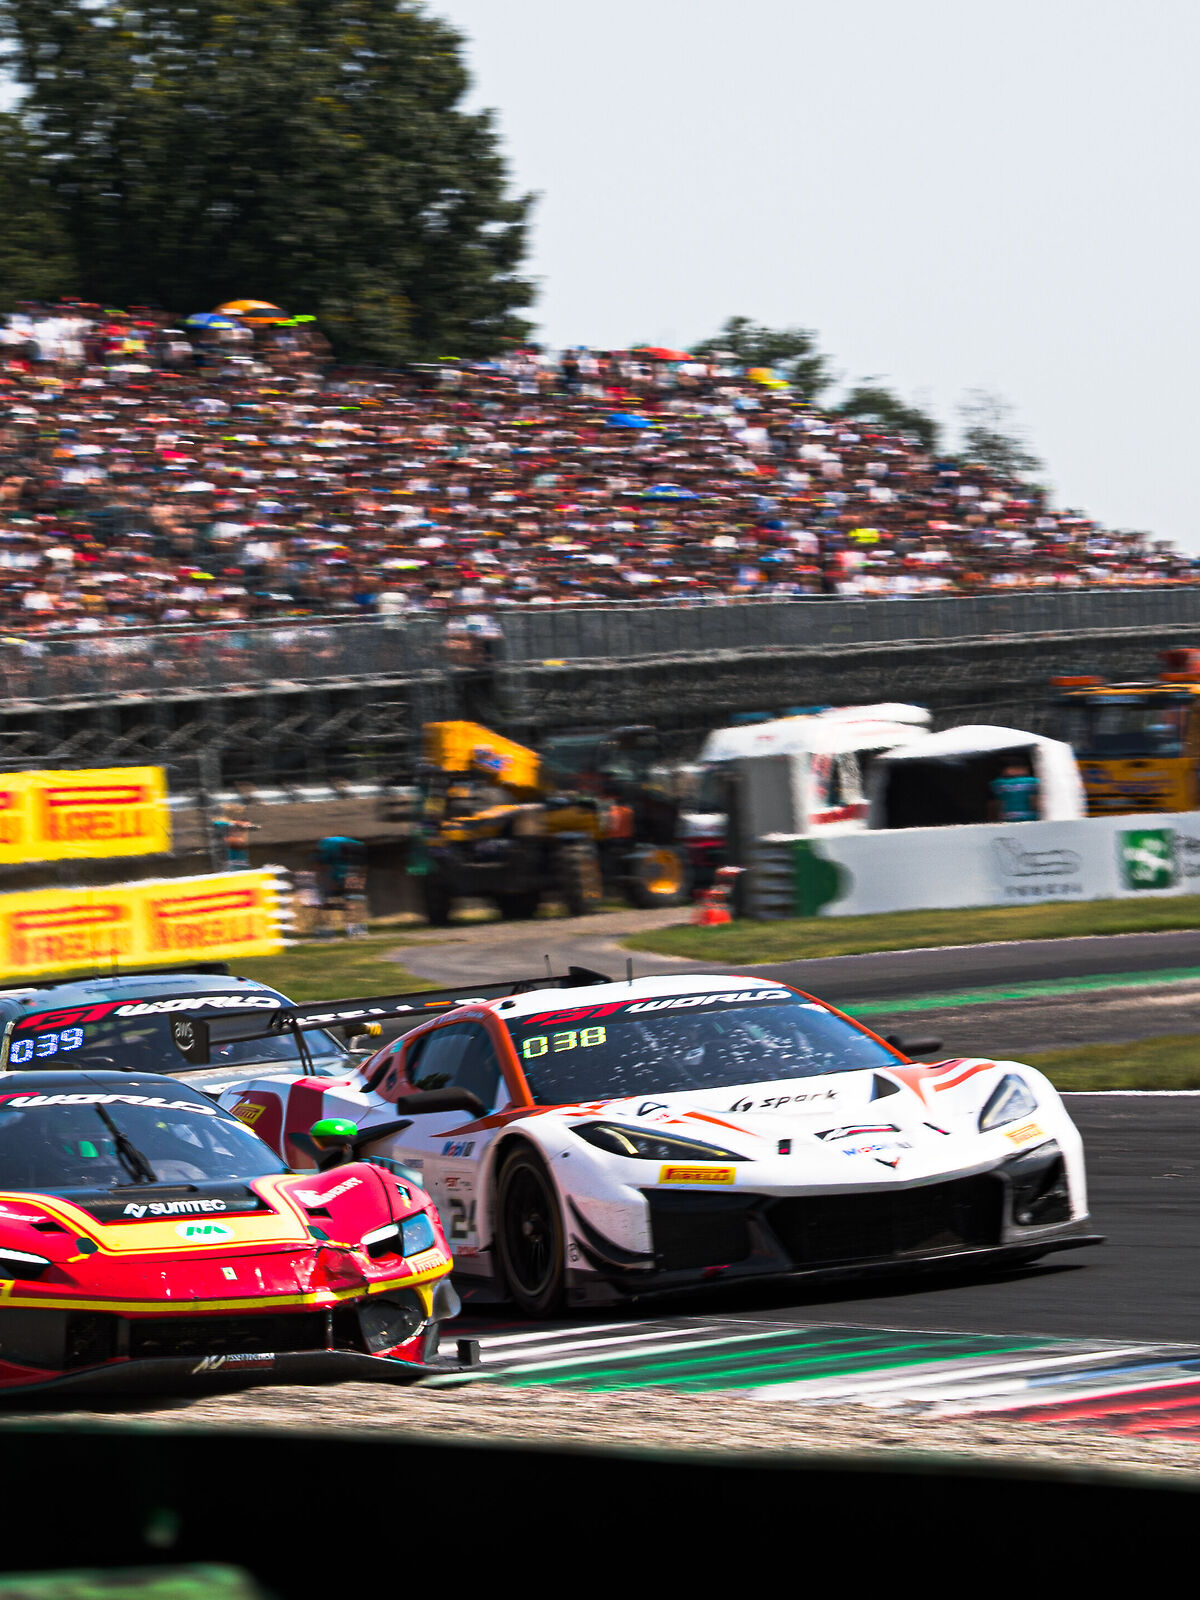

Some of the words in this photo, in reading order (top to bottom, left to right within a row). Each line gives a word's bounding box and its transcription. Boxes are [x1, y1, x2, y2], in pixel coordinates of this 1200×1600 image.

[41, 785, 149, 841] PIRELLI
[148, 889, 258, 951] PIRELLI
[10, 904, 134, 965] PIRELLI
[114, 996, 282, 1017] WORLD
[624, 989, 793, 1014] WORLD
[174, 1021, 194, 1039] aws
[9, 1027, 85, 1063] 039
[522, 1026, 607, 1059] 038
[8, 1093, 217, 1116] WORLD
[760, 1088, 839, 1111] spark
[666, 1167, 731, 1181] PIRELLI
[149, 1198, 227, 1215] SUMTEC
[411, 1253, 448, 1275] PIRELLI
